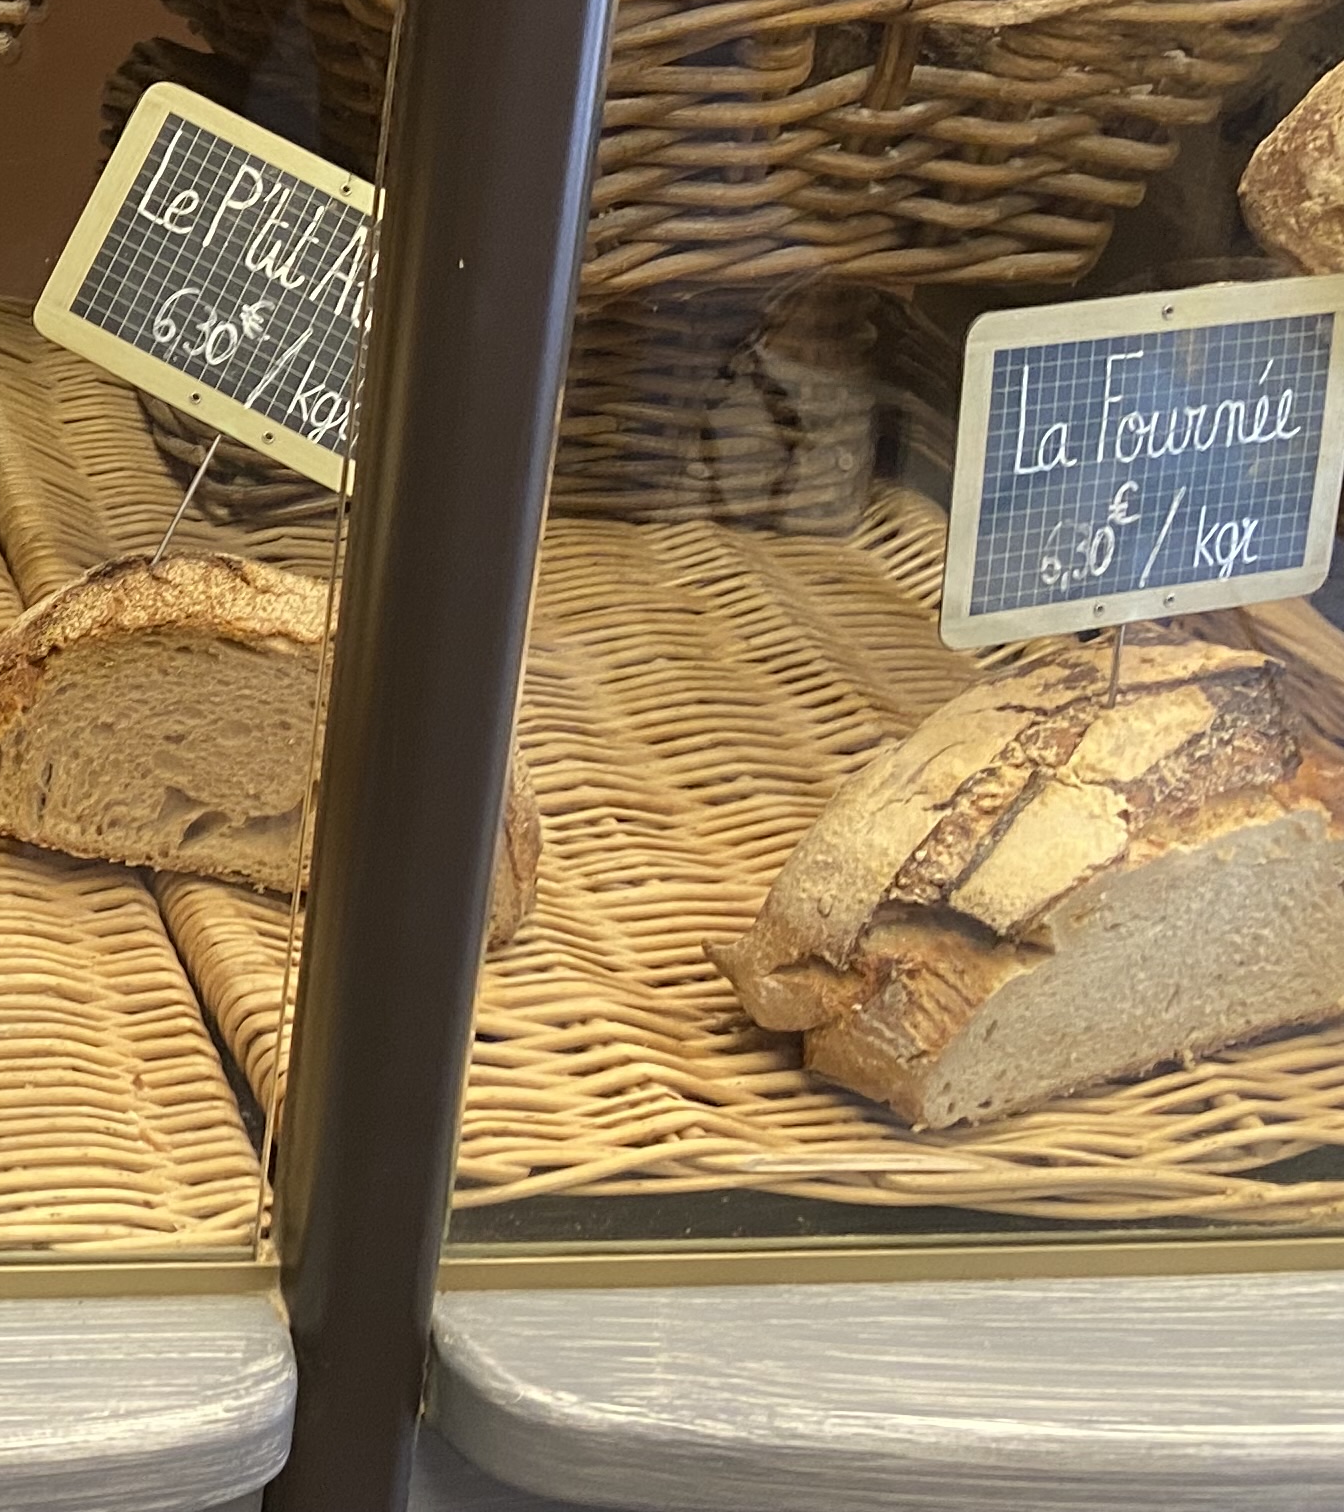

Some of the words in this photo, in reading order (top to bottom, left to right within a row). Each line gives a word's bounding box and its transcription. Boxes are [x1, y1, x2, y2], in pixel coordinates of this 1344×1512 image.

[137, 129, 200, 235] Le
[1013, 363, 1078, 476] La
[1097, 349, 1303, 464] Fournée
